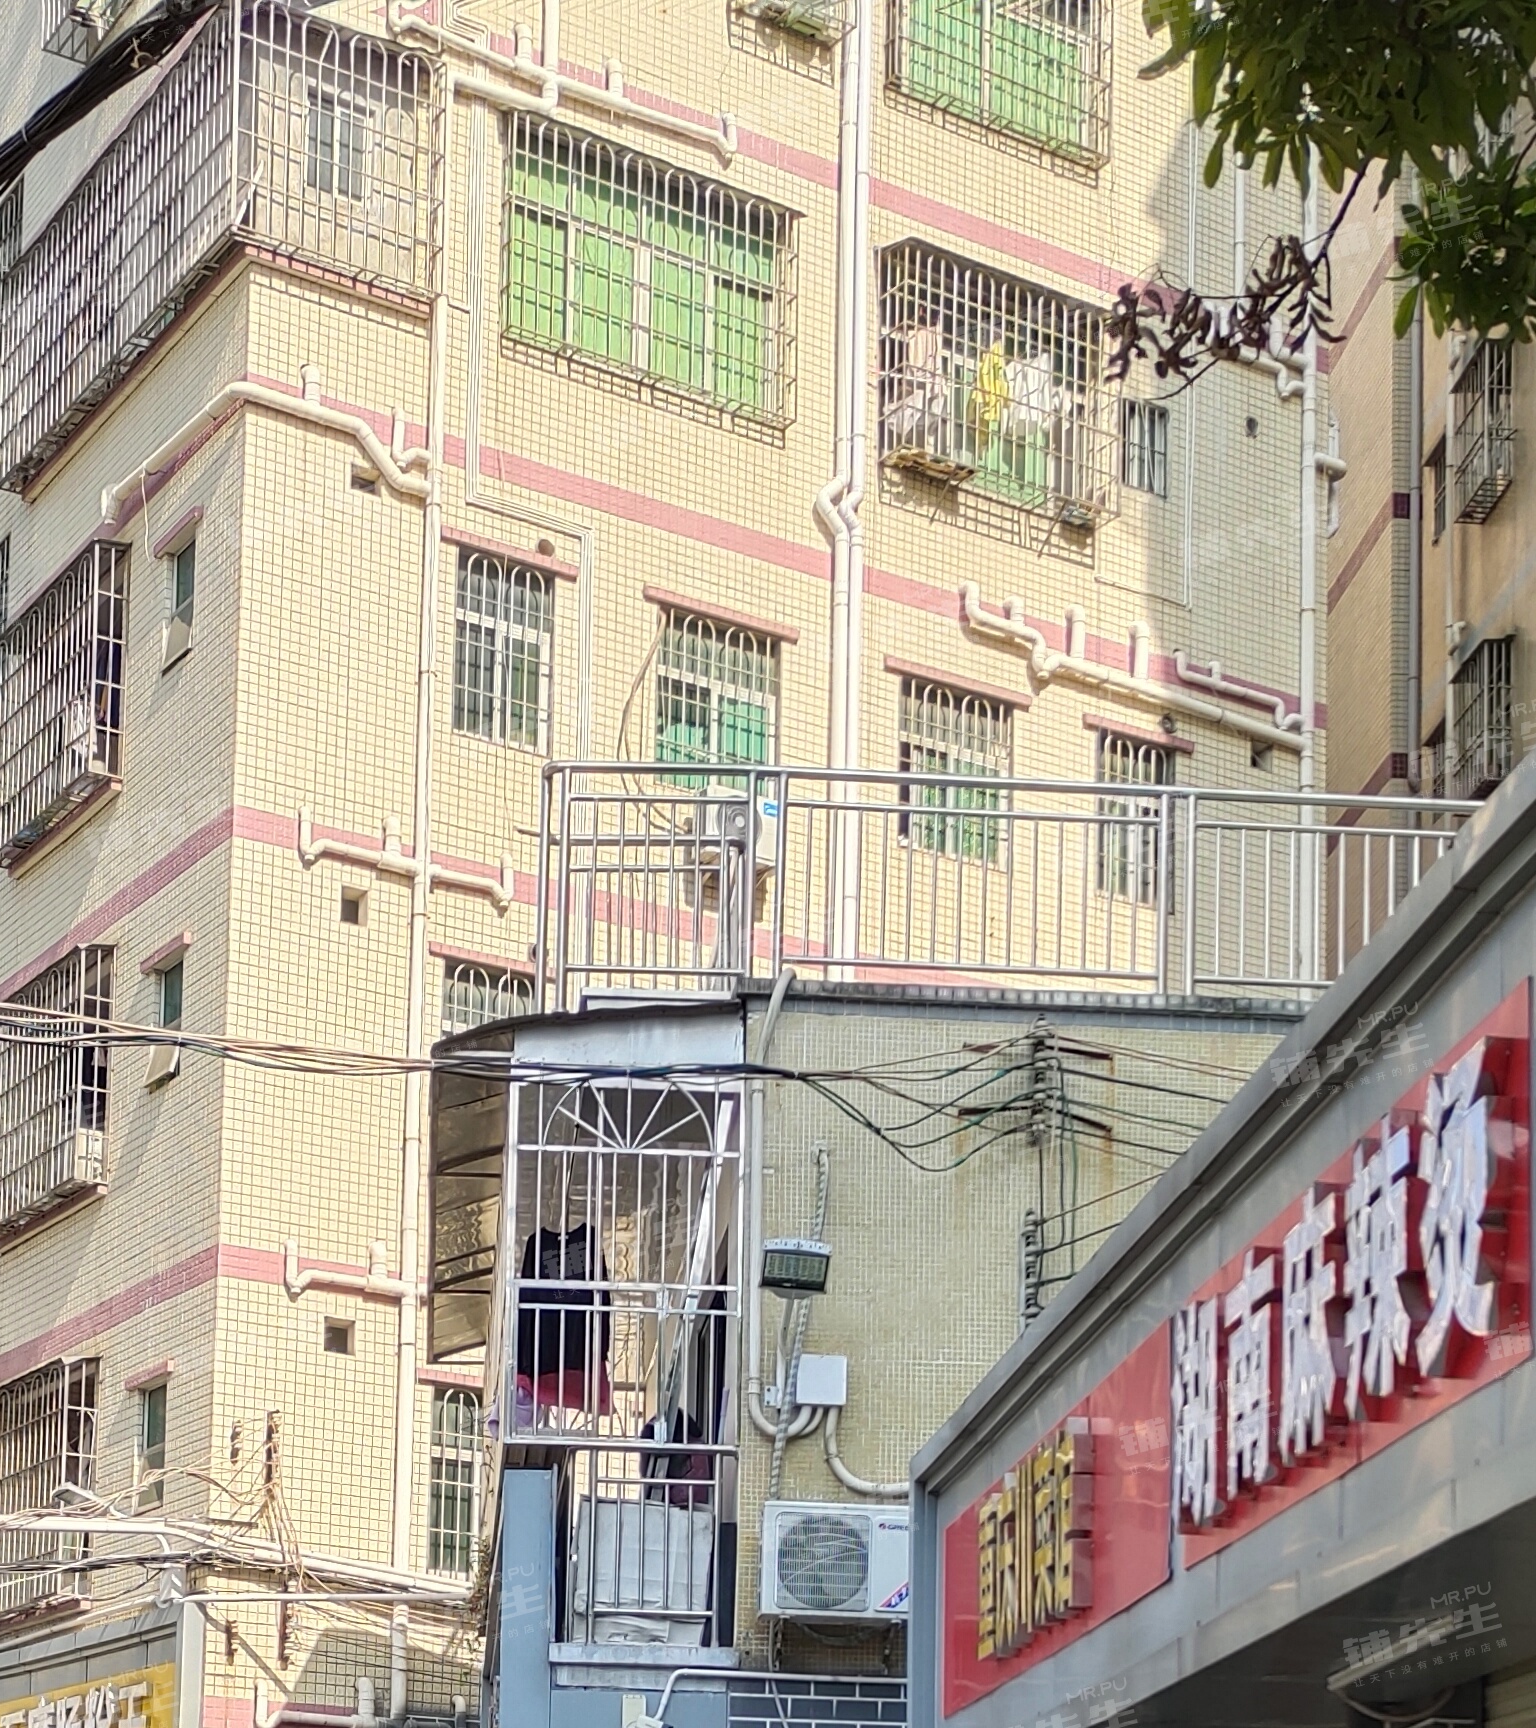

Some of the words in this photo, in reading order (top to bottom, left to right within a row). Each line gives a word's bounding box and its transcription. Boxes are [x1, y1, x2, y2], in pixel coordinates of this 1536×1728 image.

[1169, 1036, 1495, 1532] 湖南麻辣烫
